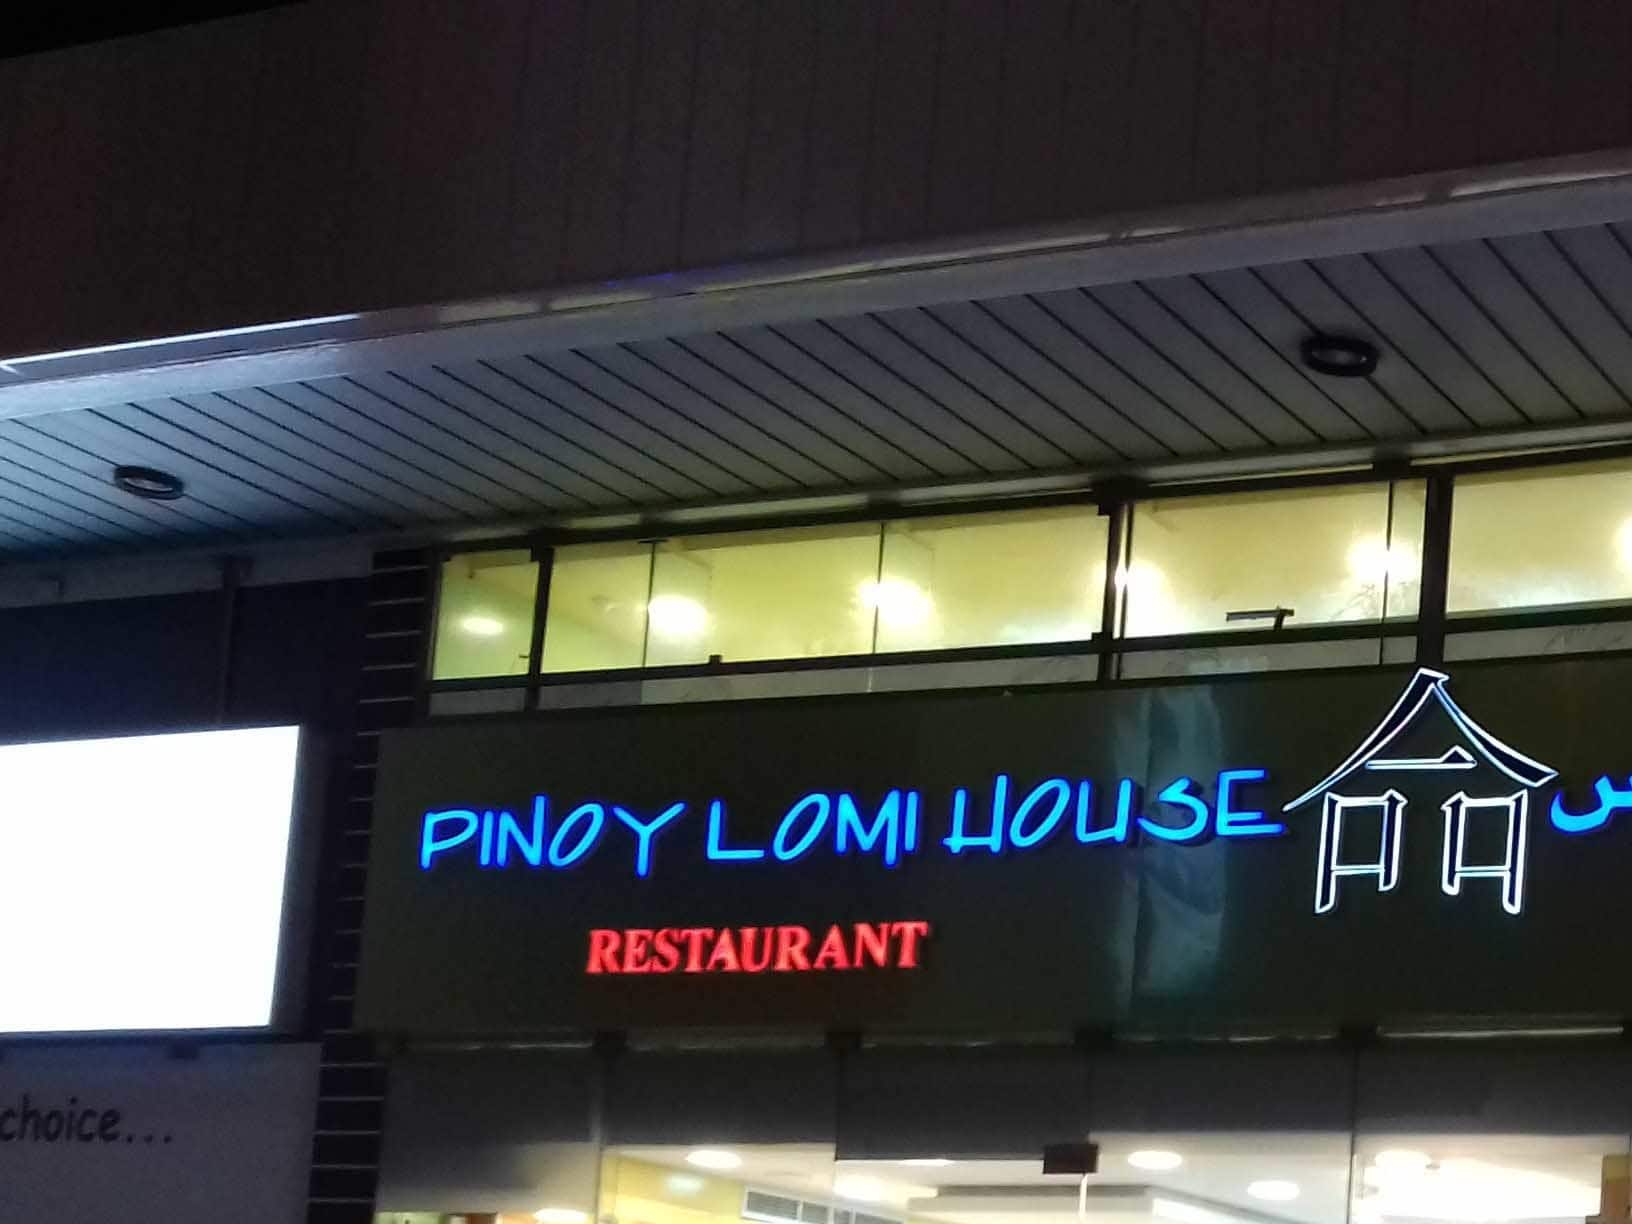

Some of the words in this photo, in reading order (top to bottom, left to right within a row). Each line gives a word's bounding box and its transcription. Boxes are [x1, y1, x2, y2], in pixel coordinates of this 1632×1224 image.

[420, 794, 686, 877] PINOY
[706, 789, 919, 867] LOMI
[942, 769, 1284, 855] HOUSE
[586, 920, 930, 975] RESTAURANT
